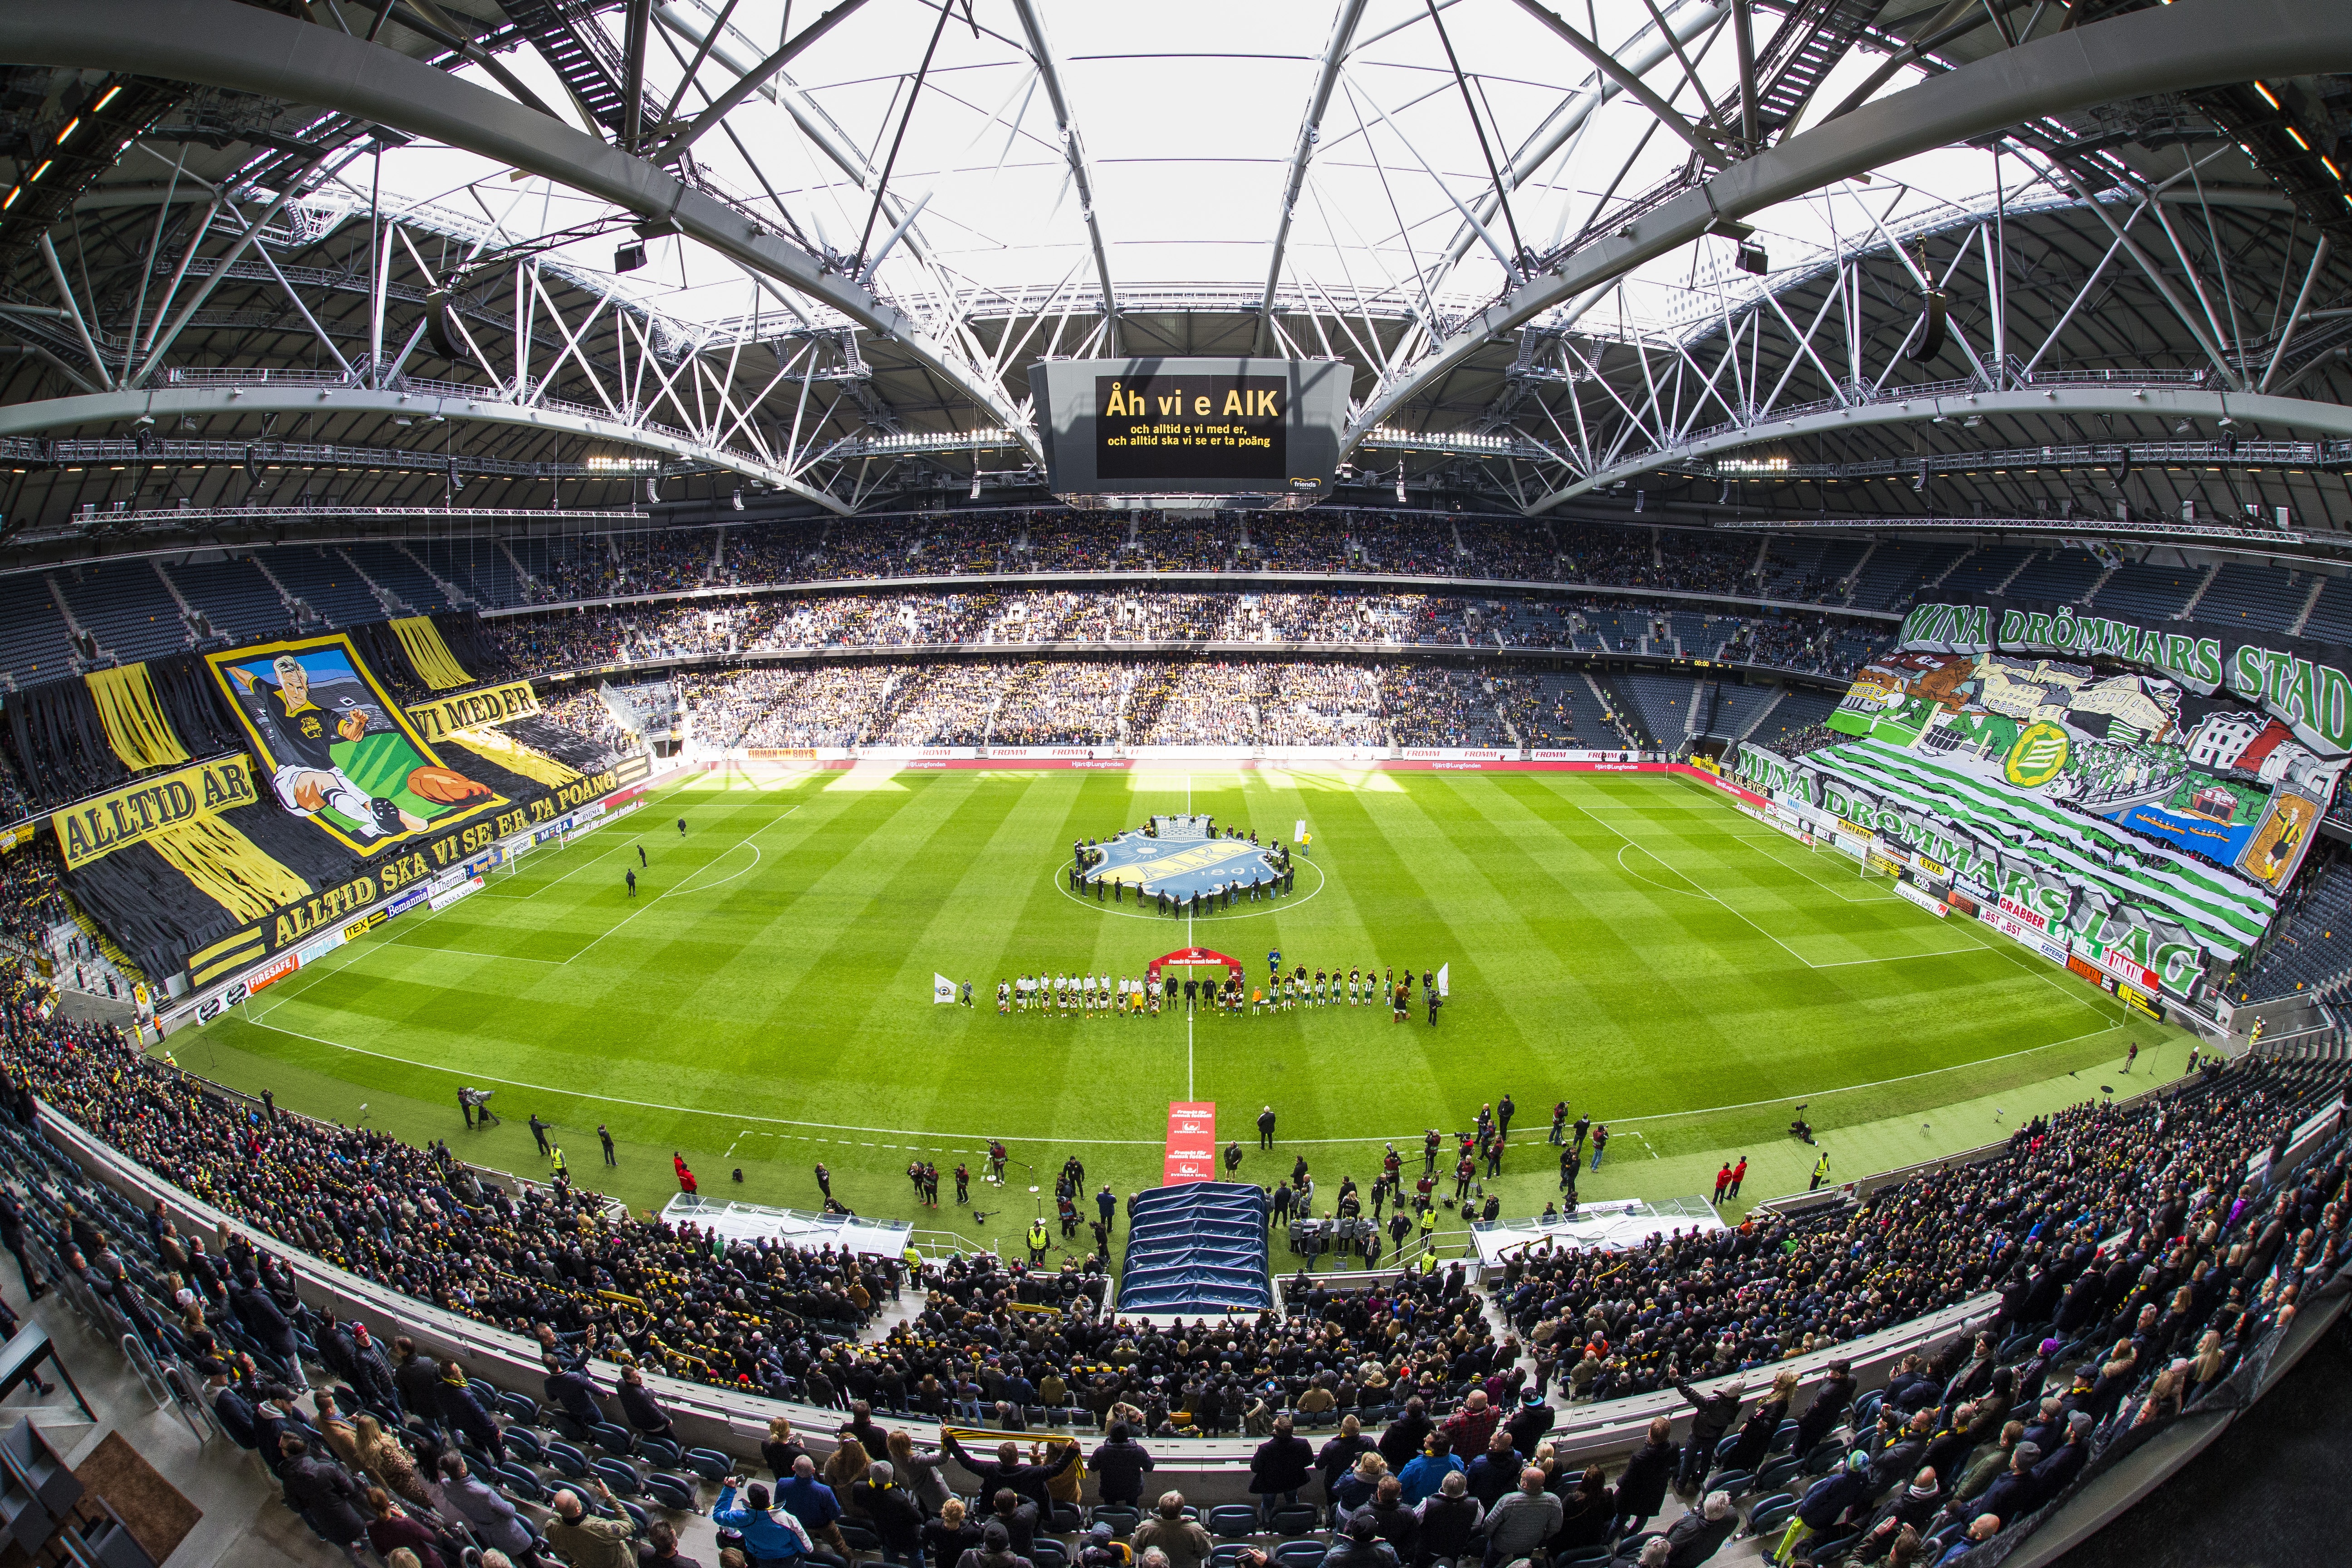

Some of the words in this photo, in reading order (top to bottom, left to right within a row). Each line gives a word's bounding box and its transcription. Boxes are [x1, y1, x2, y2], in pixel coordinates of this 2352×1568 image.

[1107, 382, 1145, 416] Åh
[1158, 390, 1181, 415] vi
[1195, 396, 1210, 415] e
[1223, 390, 1278, 416] AIK
[1131, 424, 1149, 434] och
[1153, 424, 1180, 433] alltid
[1194, 424, 1203, 433] vi
[1207, 424, 1230, 434] med
[1233, 426, 1247, 435] er,
[1108, 436, 1126, 446] och
[1130, 436, 1157, 445] alltid
[1161, 436, 1179, 445] ska
[1182, 436, 1191, 445] vi
[1225, 436, 1235, 445] ta
[1239, 436, 1270, 447] poäng
[1901, 604, 1989, 644] MINA
[1998, 606, 2221, 686] DRÖMMARS
[2235, 645, 2352, 751] STAD
[409, 708, 446, 740] VI
[748, 750, 777, 759] FIRMAN
[793, 749, 814, 758] BOYS
[1735, 774, 1768, 796] XL-BYGG
[67, 780, 196, 860] ALLTID
[204, 763, 253, 809] ÄR
[583, 808, 600, 820] BYGMA
[1787, 796, 1800, 813] KNAUF
[513, 839, 529, 853] weber
[1838, 837, 1862, 858] Flinks
[274, 877, 377, 948] ALLTID
[381, 852, 431, 893] SKA
[431, 832, 460, 866] VI
[462, 822, 493, 854] SE
[496, 807, 530, 838] ER
[530, 797, 558, 822] TA
[557, 770, 617, 811] POÄNG
[1922, 858, 1941, 873] EVVA
[437, 871, 466, 891] Thermia
[1735, 745, 1815, 807] MINA
[1823, 786, 2072, 922] DRÖMMARS
[2079, 910, 2205, 999] LAG
[1955, 874, 1991, 898] Rubber
[388, 891, 428, 917] Bemannia
[435, 893, 461, 910] SVENSKA
[463, 887, 476, 896] SPEL
[1895, 887, 1920, 903] SVENSKA
[1921, 901, 1934, 912] SPEL
[1986, 911, 2000, 925] BST
[1999, 897, 2045, 929] GRABBER
[2006, 922, 2021, 936] BST
[301, 937, 338, 965] Flinks
[2042, 944, 2066, 962] KATEPAL
[250, 958, 291, 988] FIRESAFE
[2111, 952, 2145, 984] TAKTIK
